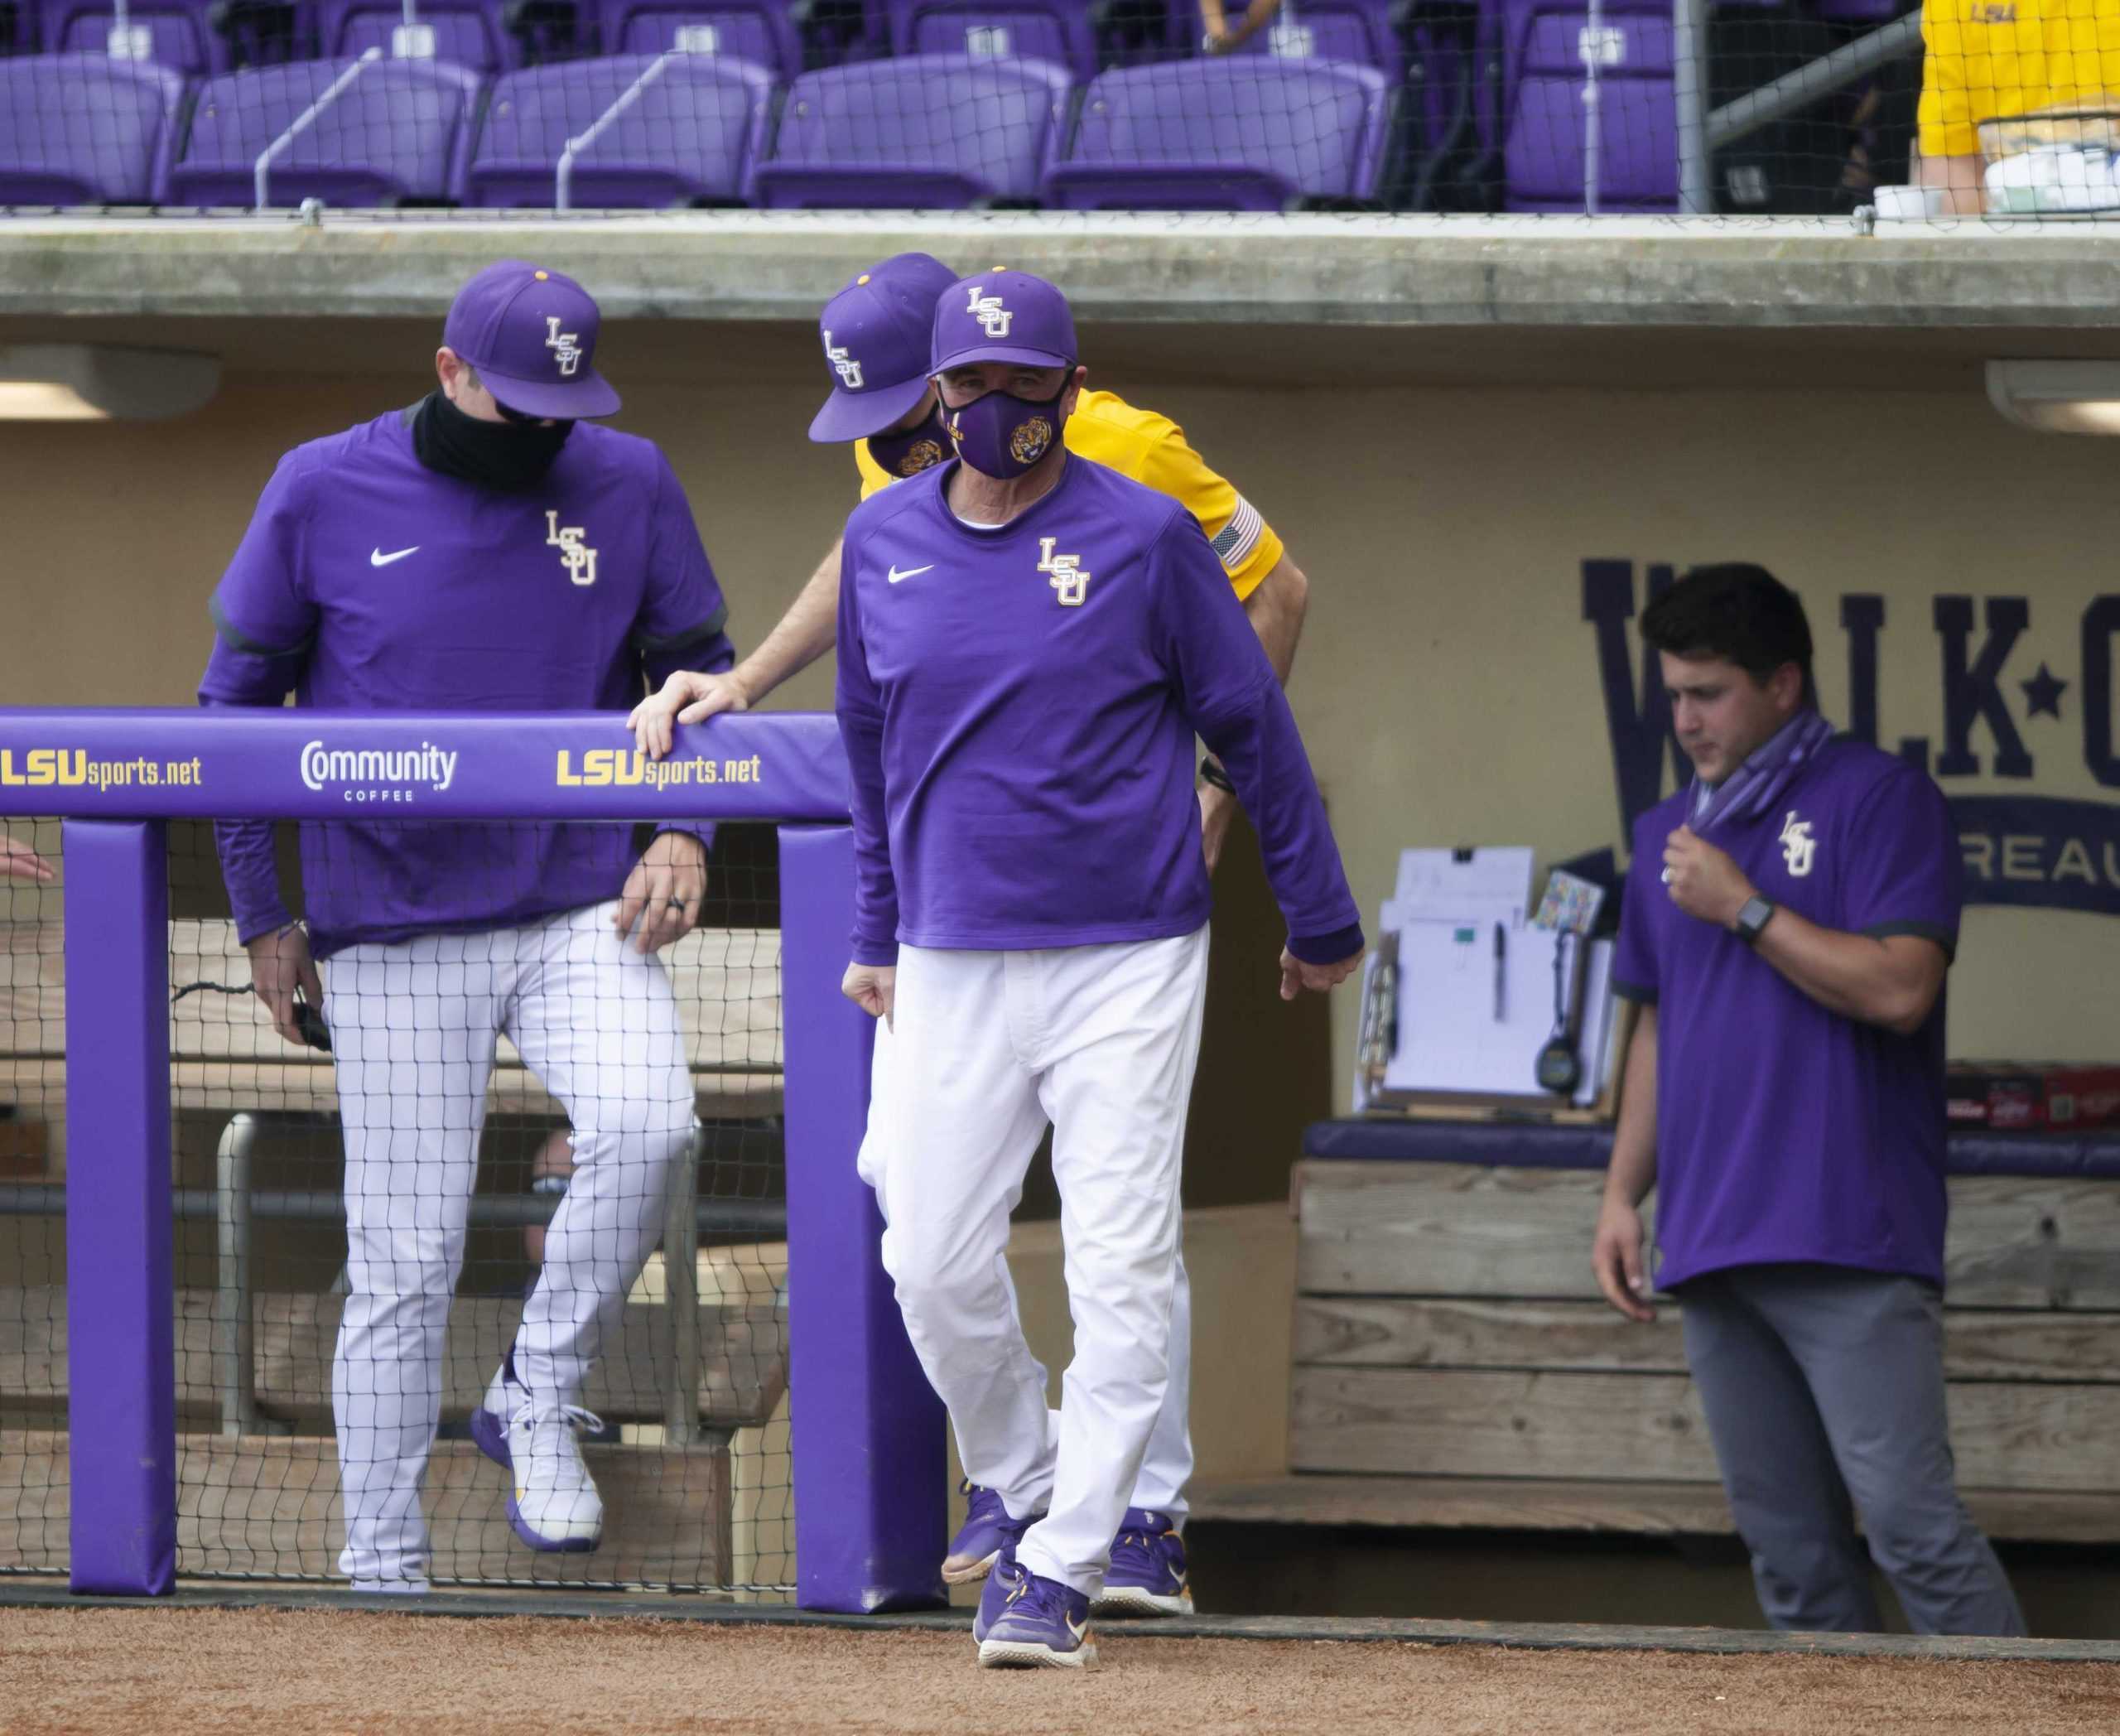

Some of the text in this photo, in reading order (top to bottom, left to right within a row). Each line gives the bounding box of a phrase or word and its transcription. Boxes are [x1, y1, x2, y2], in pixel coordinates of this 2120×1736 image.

[966, 286, 1013, 338] LSU
[546, 316, 581, 374] LSU
[823, 330, 864, 388] LSU
[546, 510, 597, 586] LSU
[1037, 537, 1091, 606] LSU
[1582, 558, 2035, 853] WLK
[0, 749, 202, 792] LSUsports.net
[301, 740, 457, 790] Community
[556, 749, 761, 792] LSUsports.net
[344, 790, 412, 802] COFFEE
[1778, 810, 1817, 878] LSU
